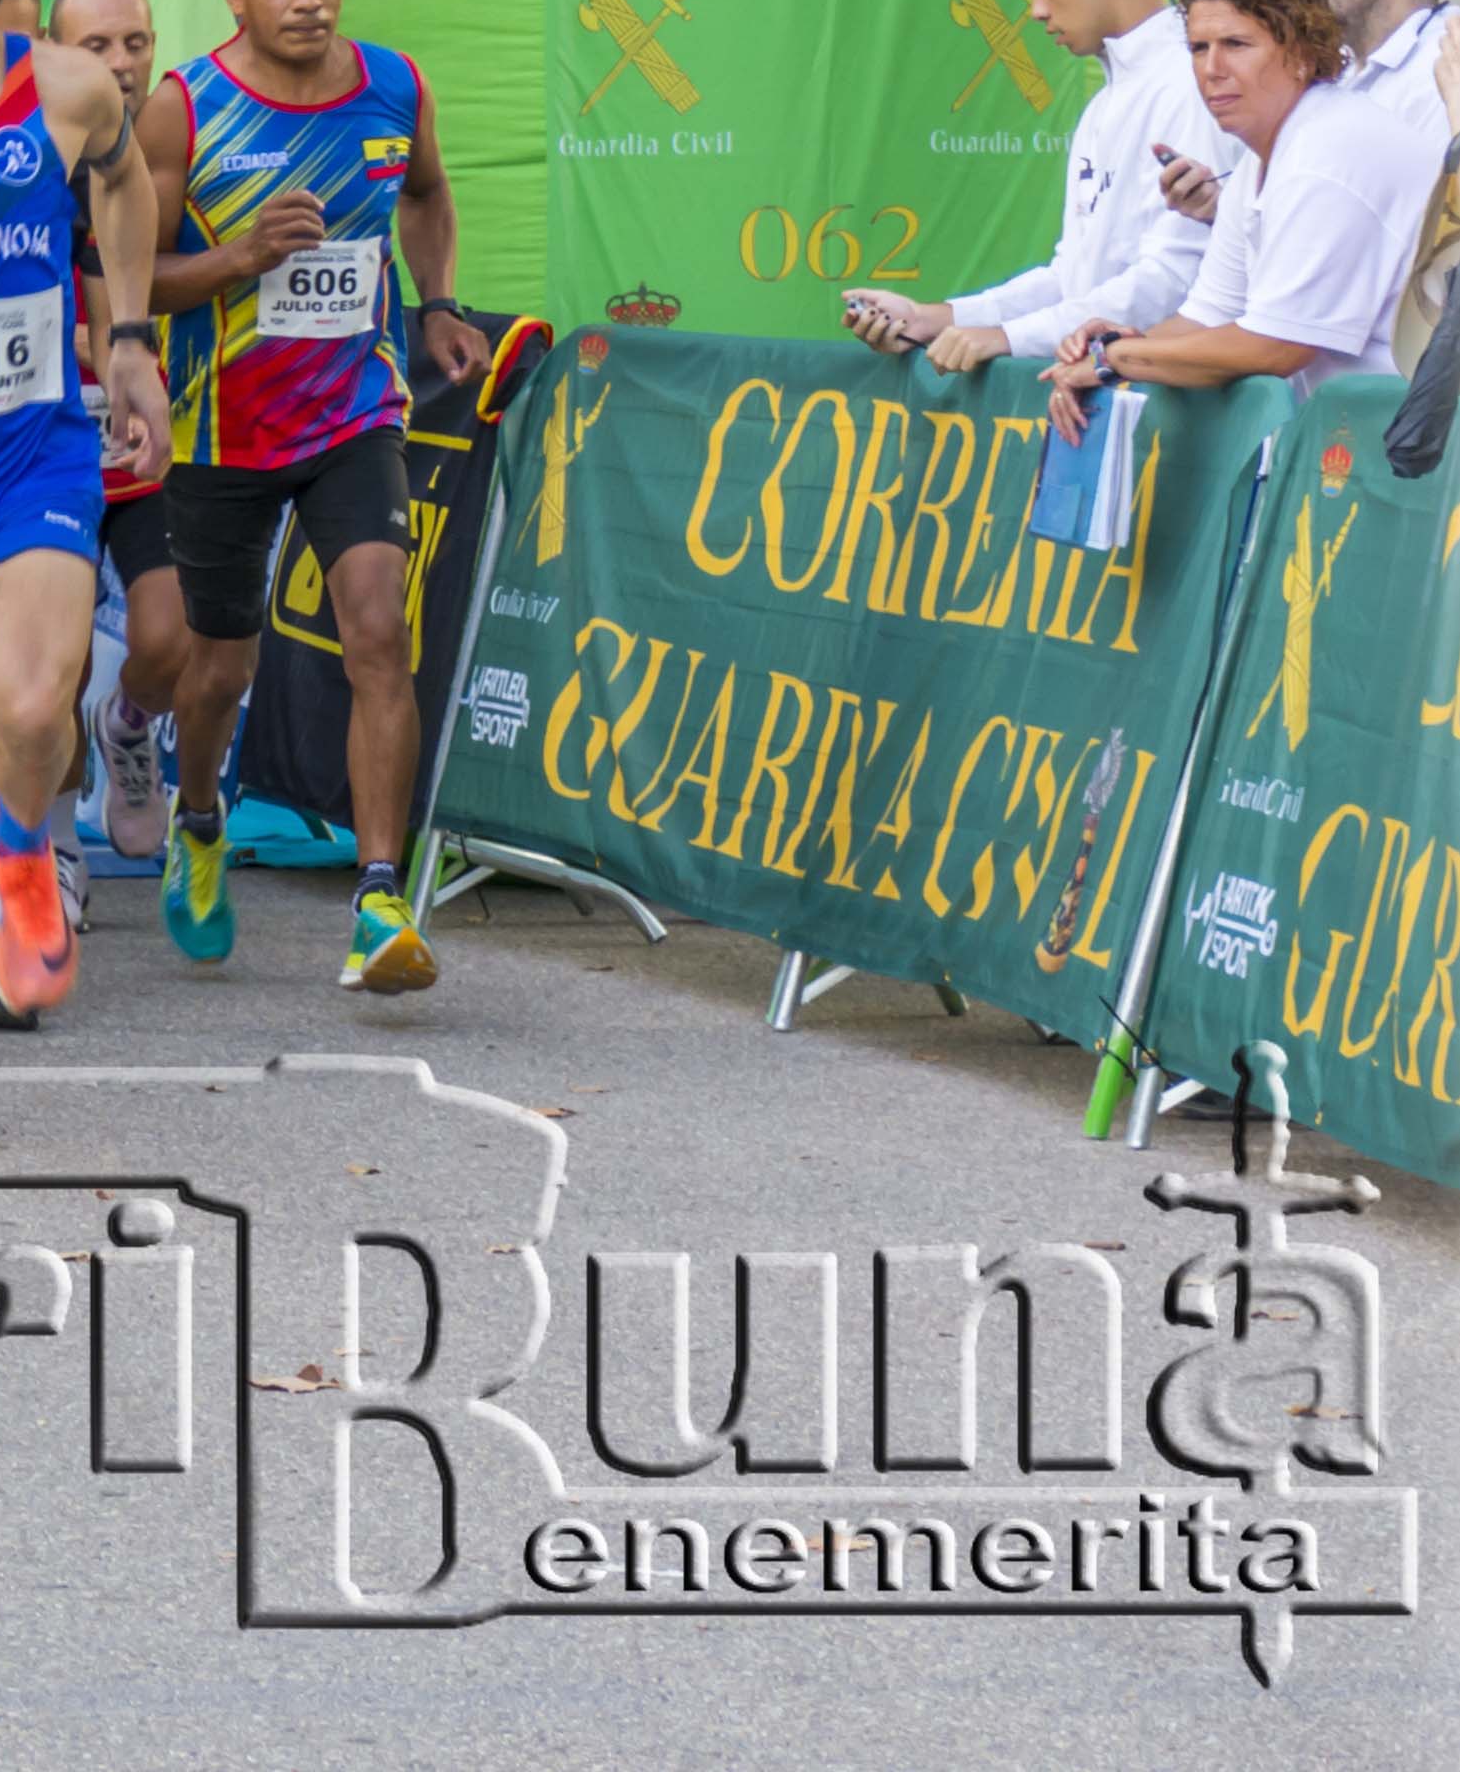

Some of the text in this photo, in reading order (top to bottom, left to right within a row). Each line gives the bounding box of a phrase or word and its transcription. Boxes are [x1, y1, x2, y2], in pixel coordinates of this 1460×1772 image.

[557, 130, 735, 158] Guardia Civil
[929, 129, 1075, 156] Guardia Civi
[222, 151, 290, 173] ECUADOR
[738, 204, 921, 282] 062
[288, 267, 358, 297] 606
[272, 299, 323, 313] JULIO
[470, 712, 521, 750] SPORT
